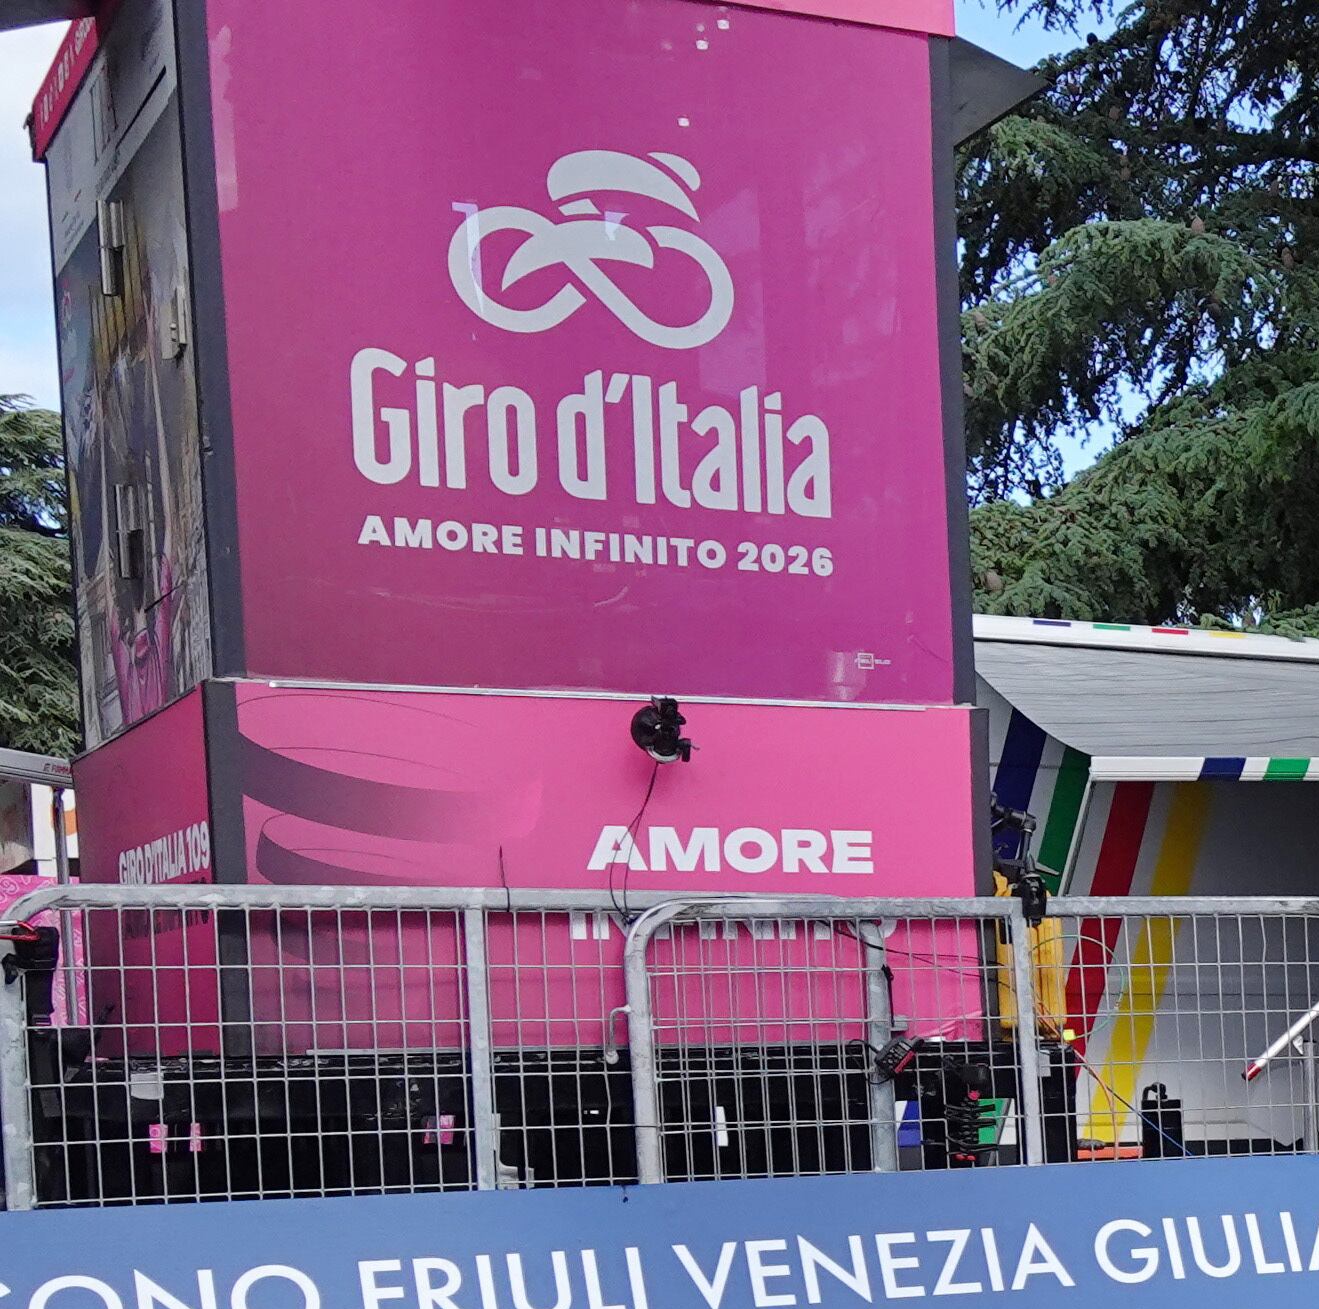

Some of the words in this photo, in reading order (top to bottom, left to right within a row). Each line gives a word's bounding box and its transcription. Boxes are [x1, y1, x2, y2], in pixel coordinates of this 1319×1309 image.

[350, 347, 539, 495] Giro
[557, 368, 832, 519] d'Italia
[357, 514, 523, 556] AMORE
[535, 526, 727, 569] INFINITO
[737, 540, 834, 578] 2026
[186, 820, 211, 872] 109
[587, 825, 875, 874] AMORE
